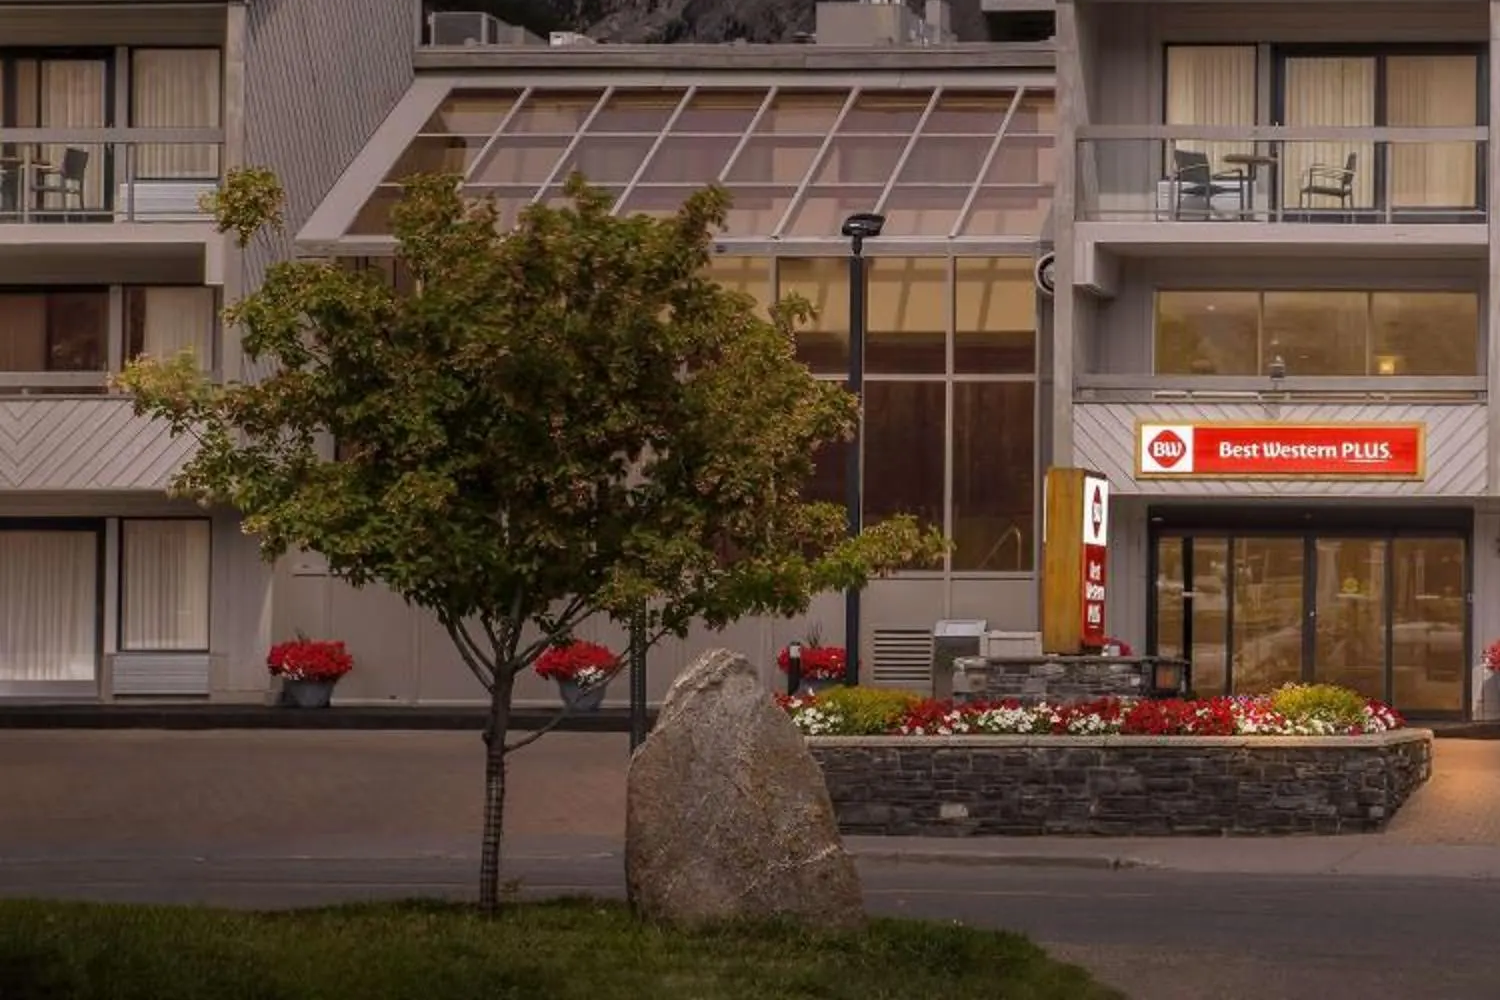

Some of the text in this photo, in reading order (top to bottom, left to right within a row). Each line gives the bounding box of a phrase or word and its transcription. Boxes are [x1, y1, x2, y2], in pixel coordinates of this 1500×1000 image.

[1153, 441, 1183, 457] BW
[1219, 441, 1259, 458] Best
[1263, 441, 1337, 458] Western
